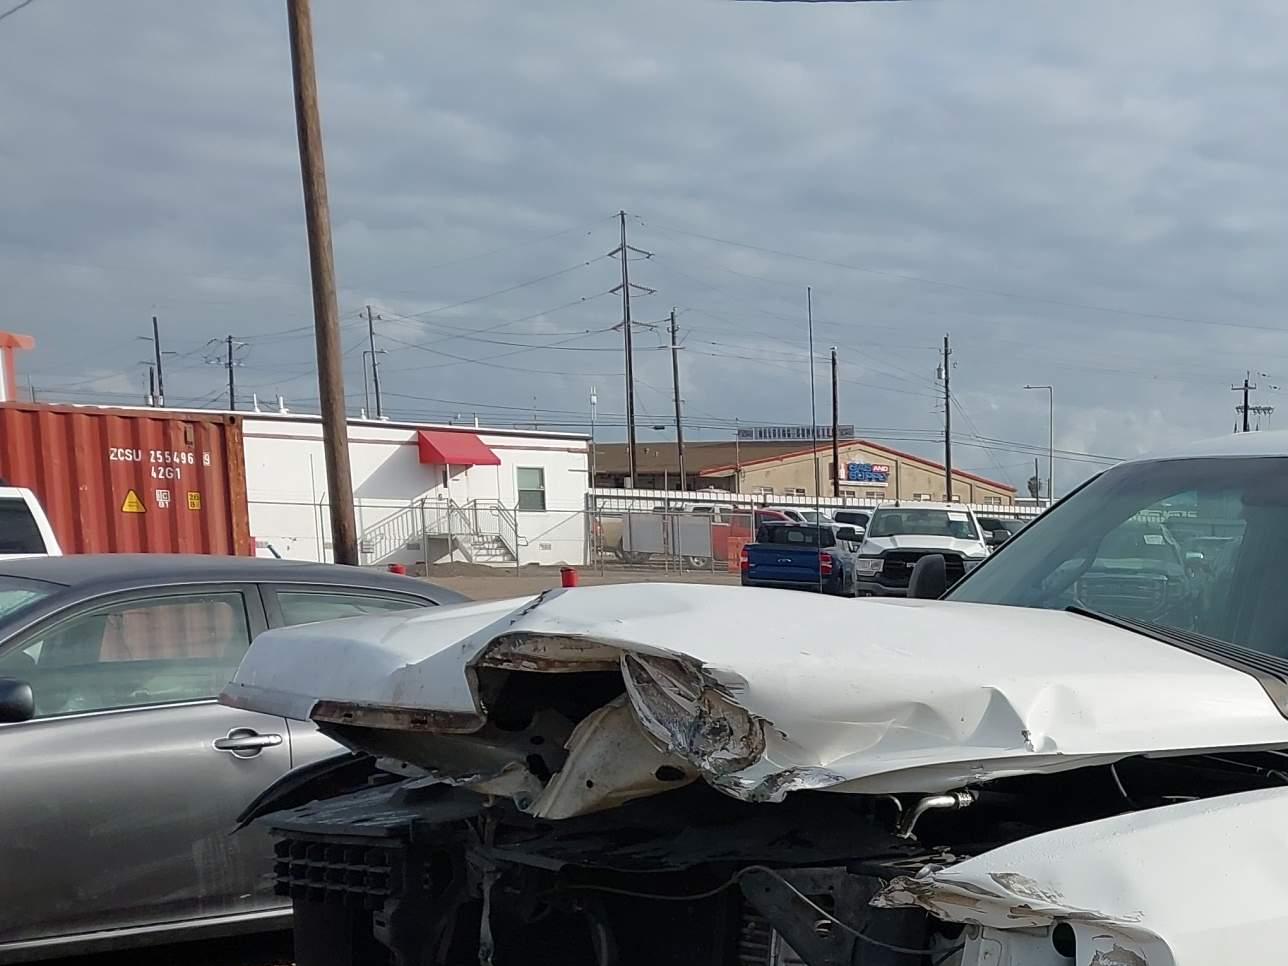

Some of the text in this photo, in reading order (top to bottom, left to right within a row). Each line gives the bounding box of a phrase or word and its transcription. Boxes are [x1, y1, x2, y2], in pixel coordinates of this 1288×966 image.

[109, 447, 142, 461] ZCSU
[149, 450, 194, 465] 255496
[151, 465, 181, 479] 42G1
[873, 464, 889, 473] AND
